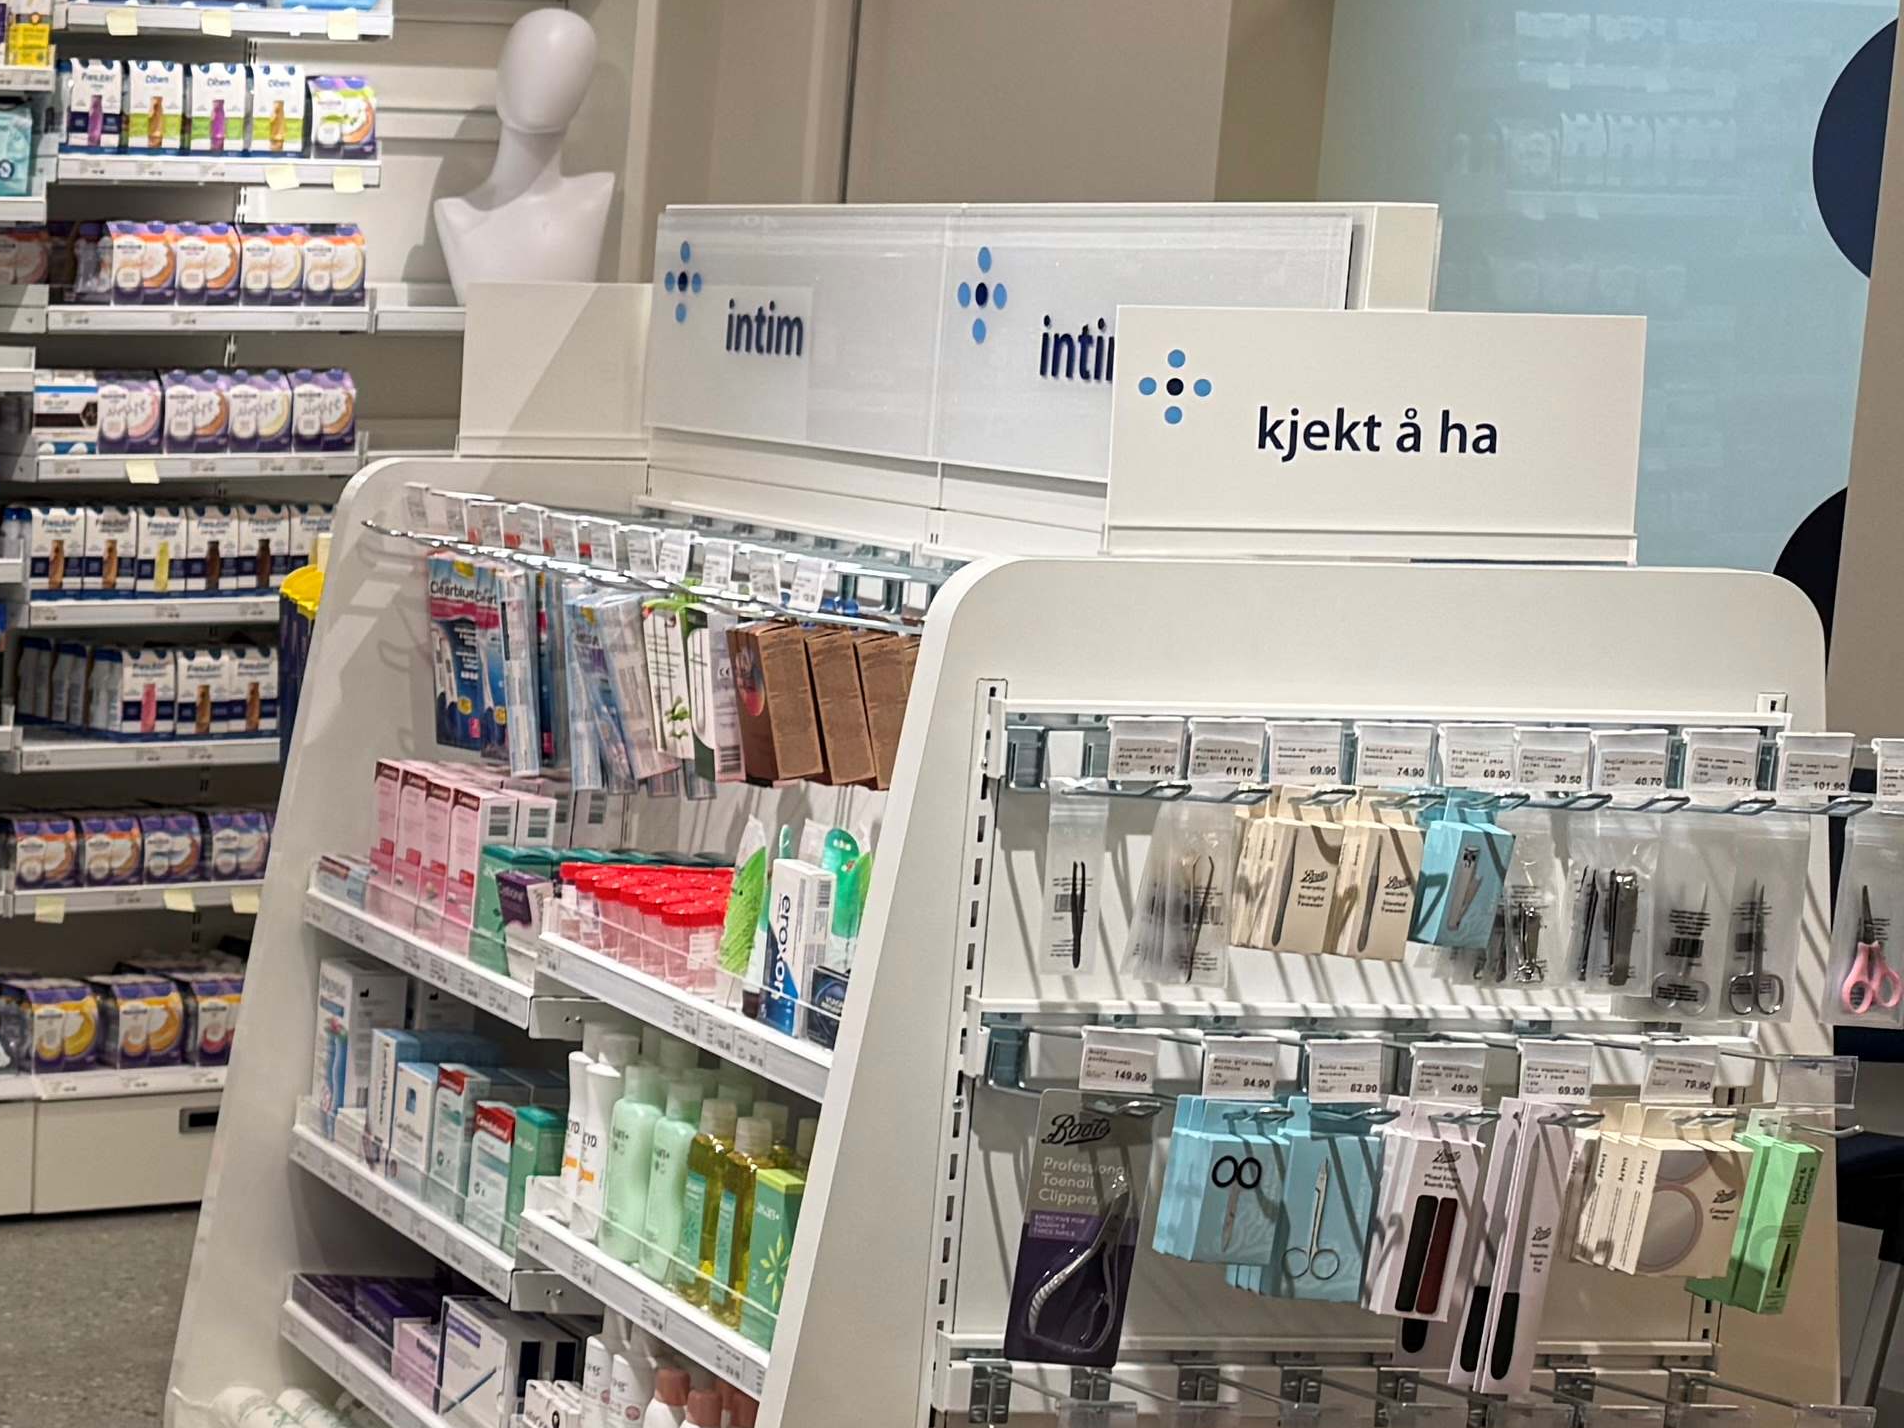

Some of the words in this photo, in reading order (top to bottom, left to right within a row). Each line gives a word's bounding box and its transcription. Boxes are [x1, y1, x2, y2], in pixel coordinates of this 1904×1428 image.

[725, 298, 803, 358] intim
[1258, 405, 1381, 464] kjekt
[1395, 407, 1423, 453] å
[1439, 409, 1498, 456] ha
[1114, 1069, 1147, 1082] 149.90
[1243, 1078, 1270, 1088] 94.90
[1042, 1114, 1110, 1146] Boots
[1042, 1175, 1094, 1189] Toenail
[1038, 1189, 1098, 1206] Clippers
